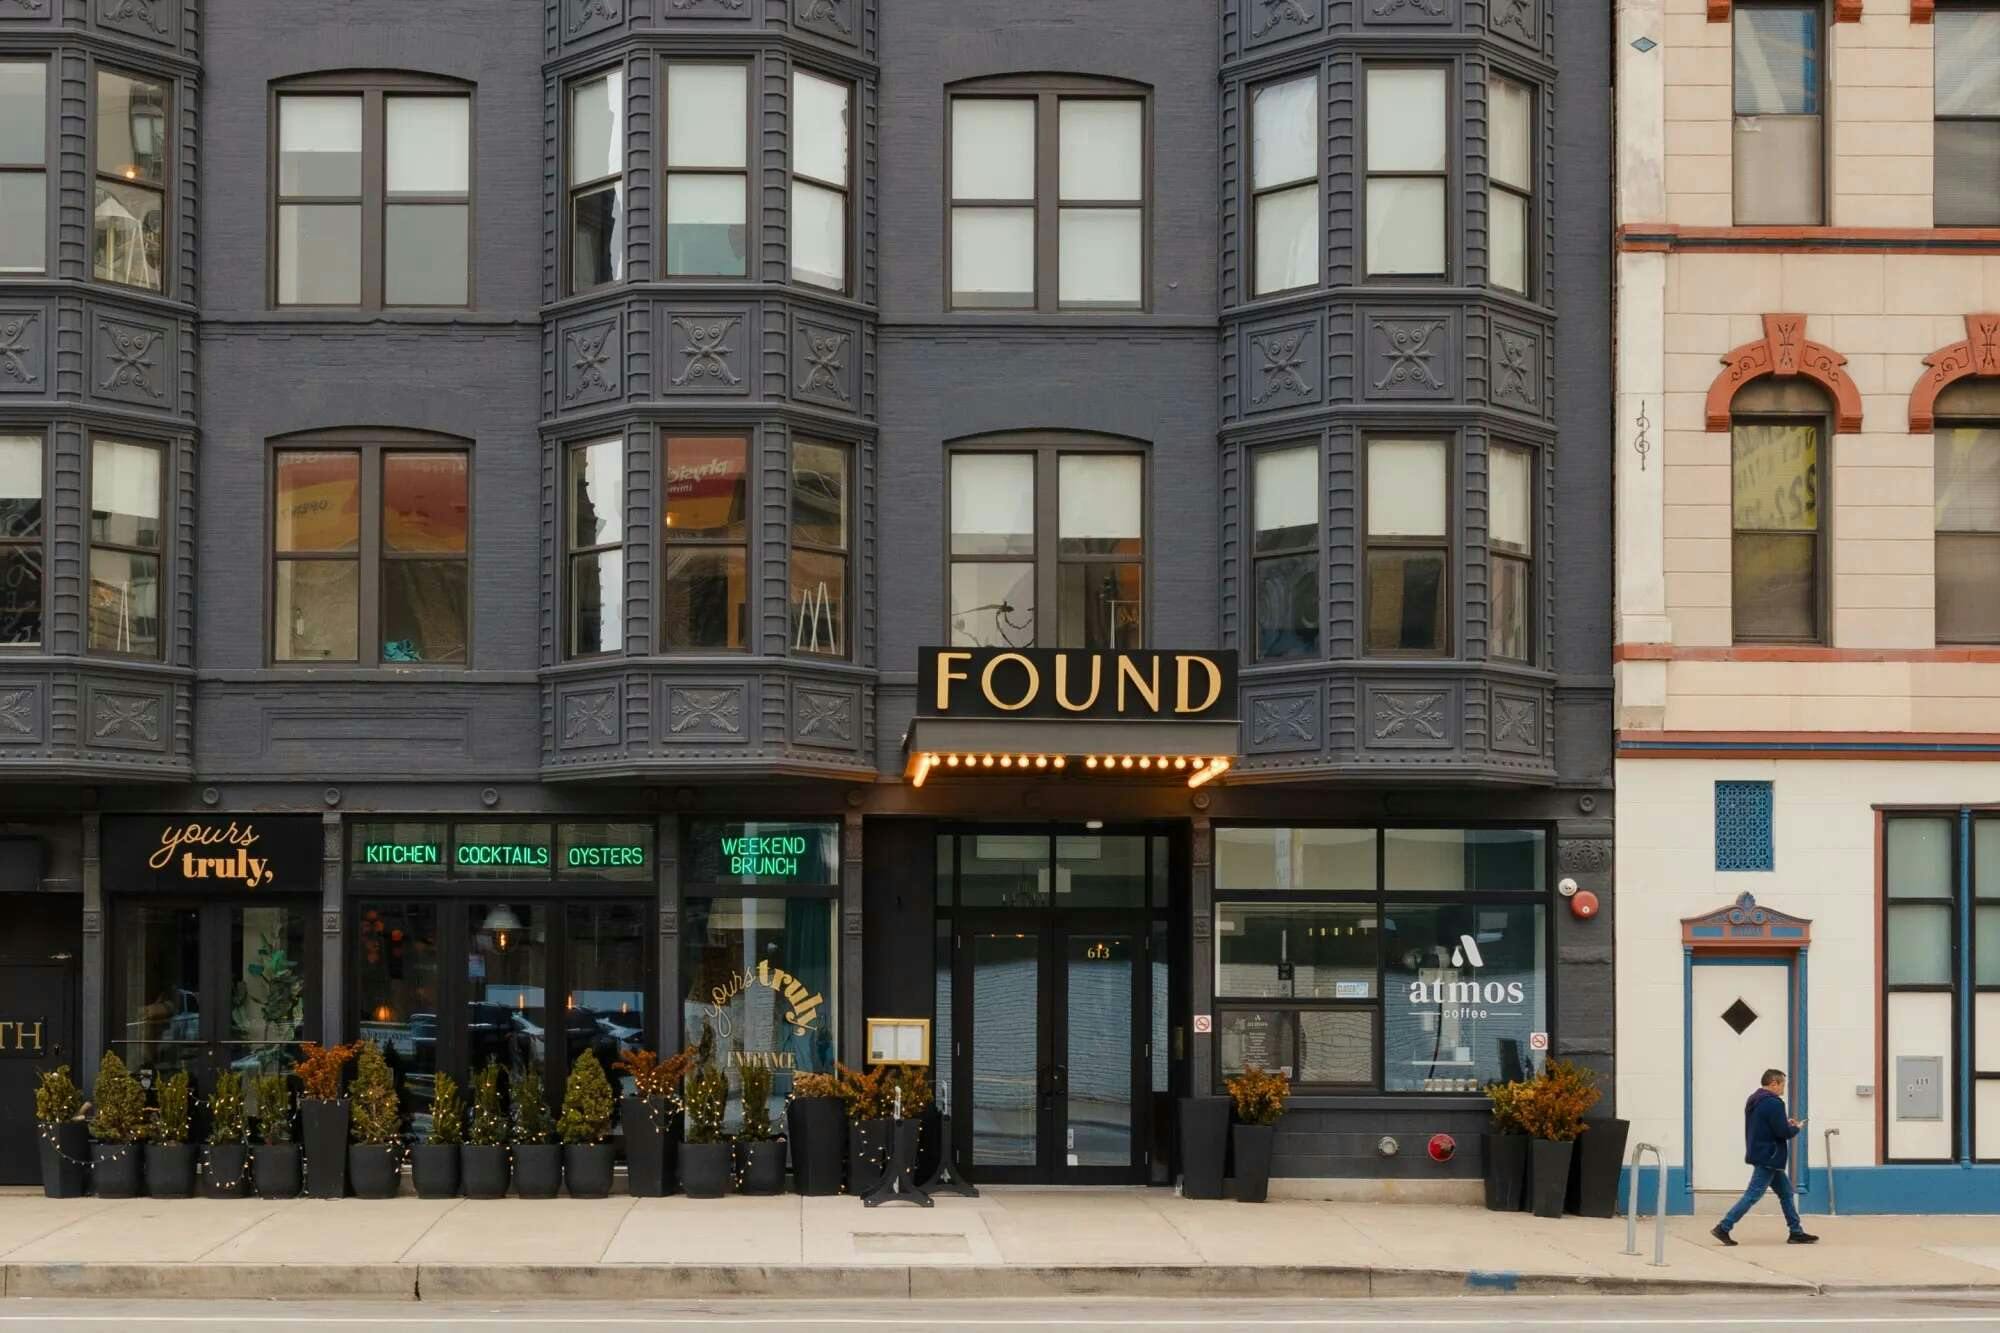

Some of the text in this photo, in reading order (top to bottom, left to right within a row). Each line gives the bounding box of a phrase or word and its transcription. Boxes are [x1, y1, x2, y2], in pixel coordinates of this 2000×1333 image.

[936, 652, 1221, 713] FOUND
[149, 821, 260, 868] yours
[721, 837, 806, 855] WEEKEND
[366, 845, 436, 864] KITCHEN
[458, 846, 548, 865] COCKTAILS
[568, 847, 643, 865] OYSTERS
[182, 848, 274, 887] truly,
[731, 857, 797, 875] BRUNCH
[1408, 977, 1524, 1004] atmos
[704, 966, 756, 1038] yours
[1443, 1007, 1488, 1019] coffee
